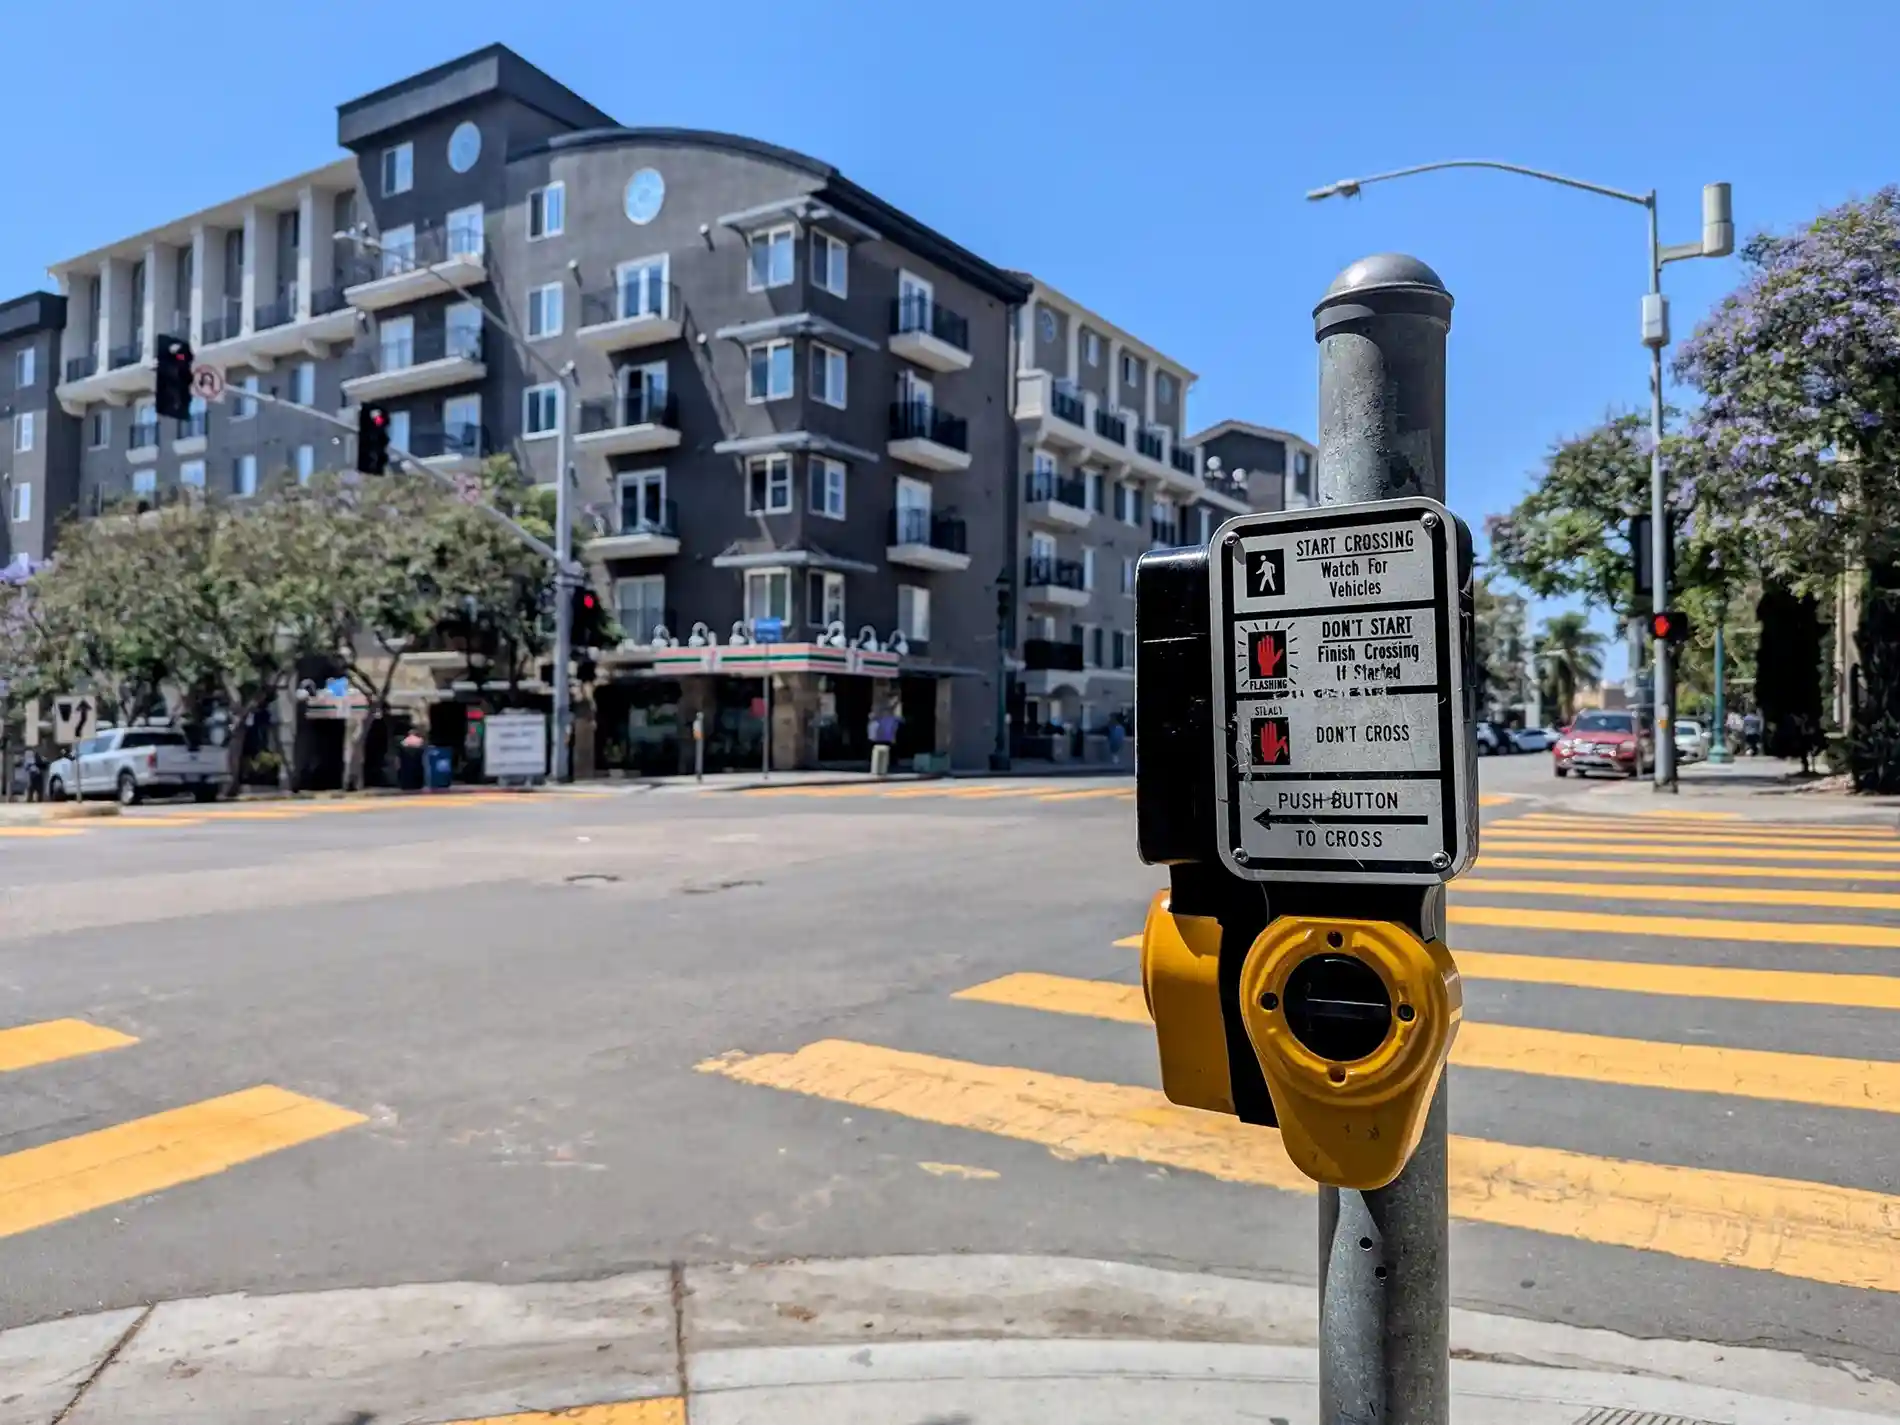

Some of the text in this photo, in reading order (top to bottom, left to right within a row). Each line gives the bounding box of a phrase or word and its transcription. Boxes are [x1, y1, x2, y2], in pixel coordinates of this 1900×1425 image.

[1296, 530, 1414, 557] START CROSSING
[1321, 558, 1388, 579] Watch For
[1329, 578, 1381, 599] Vehicles
[1322, 616, 1413, 638] DON'T START
[1317, 641, 1419, 662] Finish Crossing
[1336, 662, 1401, 681] If Started
[1249, 679, 1287, 690] FLASHING
[1316, 724, 1410, 743] DON'T CROSS
[1278, 792, 1398, 809] PUSH BUTTON
[1296, 830, 1383, 848] TO CROSS
